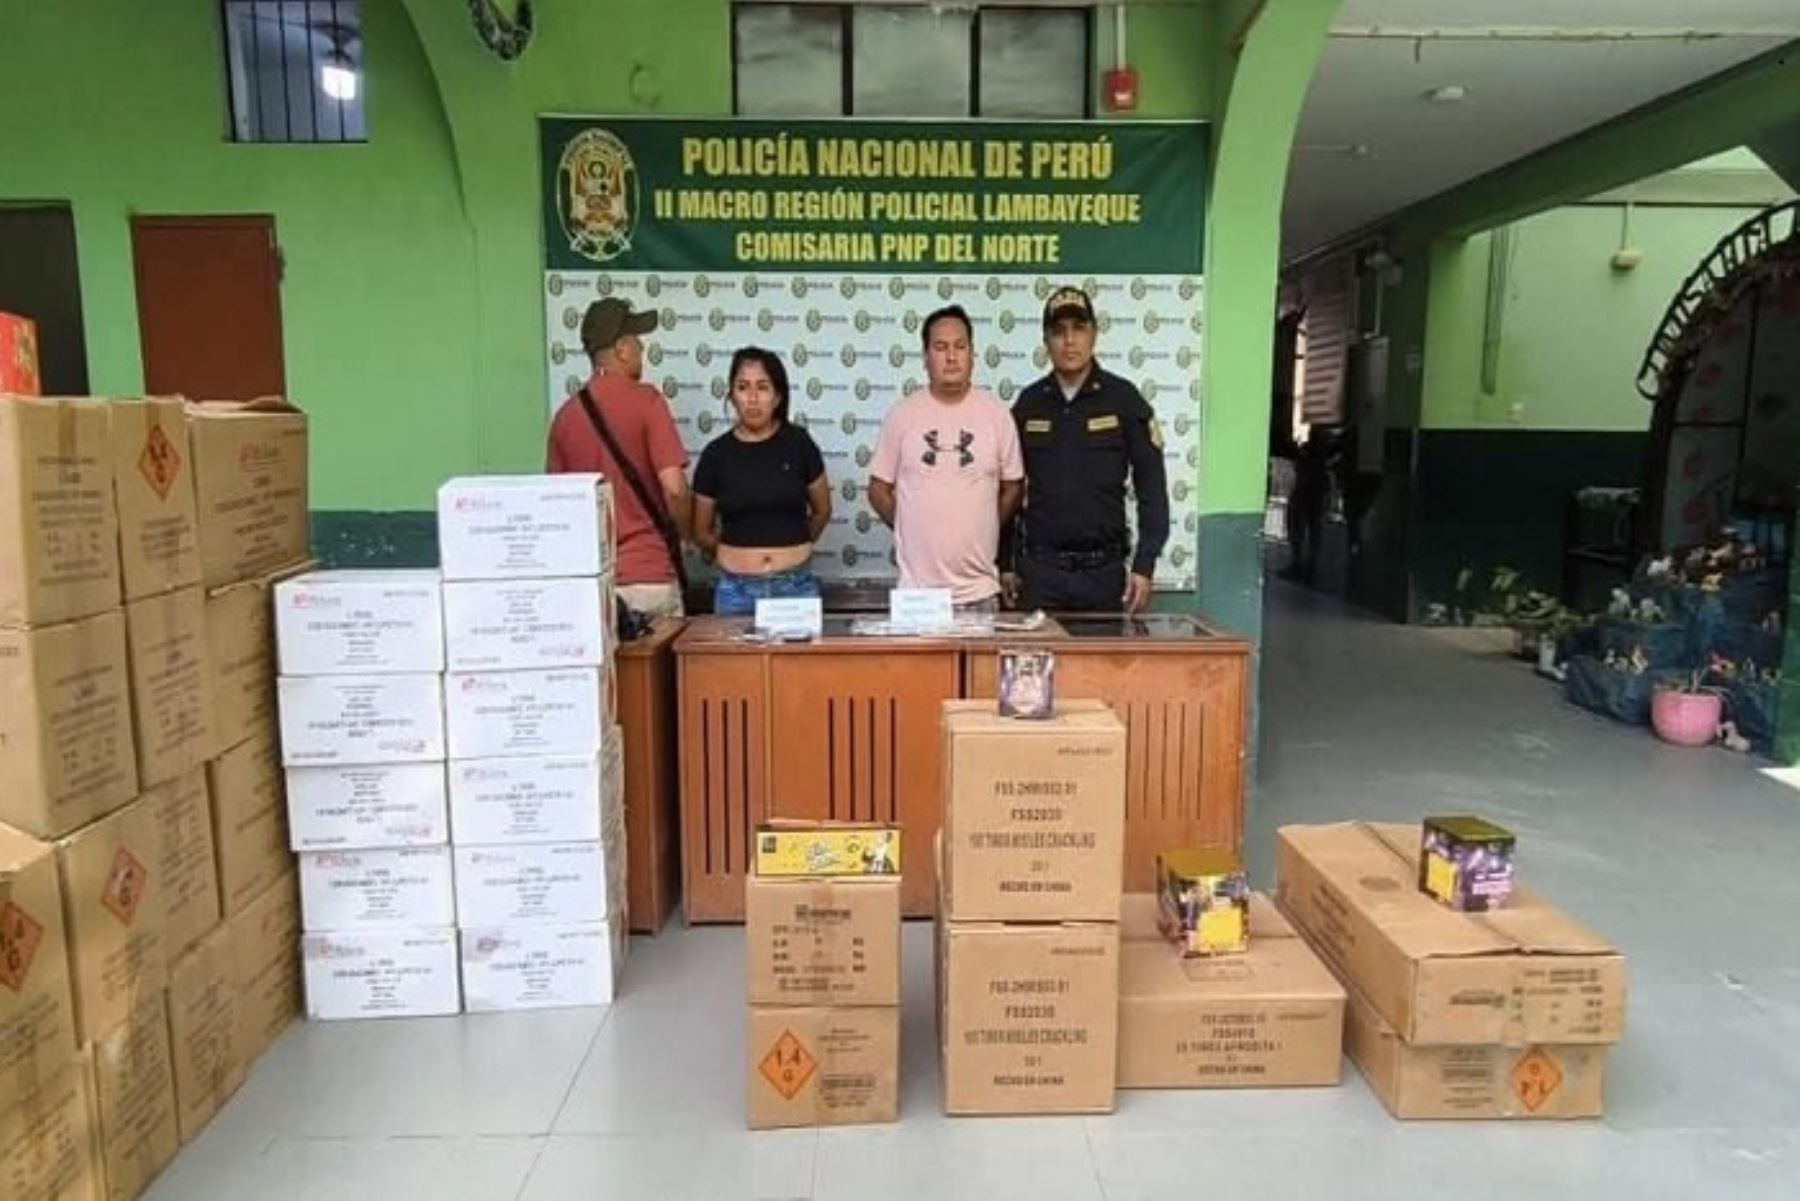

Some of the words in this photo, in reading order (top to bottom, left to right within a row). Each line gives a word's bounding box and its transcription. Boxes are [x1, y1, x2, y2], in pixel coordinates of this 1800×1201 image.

[682, 132, 811, 176] POLICÍA
[817, 138, 977, 178] NACIONAL
[983, 140, 1024, 179] DE
[1031, 135, 1113, 179] PERÚ
[654, 189, 674, 219] II
[678, 189, 769, 219] MACRO
[773, 186, 865, 220] REGIÓN
[870, 190, 979, 222] POLICIAL
[983, 193, 1141, 226] LAMBAYEQUE
[736, 231, 877, 262] COMISARIA
[880, 232, 929, 263] PNP
[934, 233, 977, 263] DEL
[982, 234, 1060, 263] NORTE
